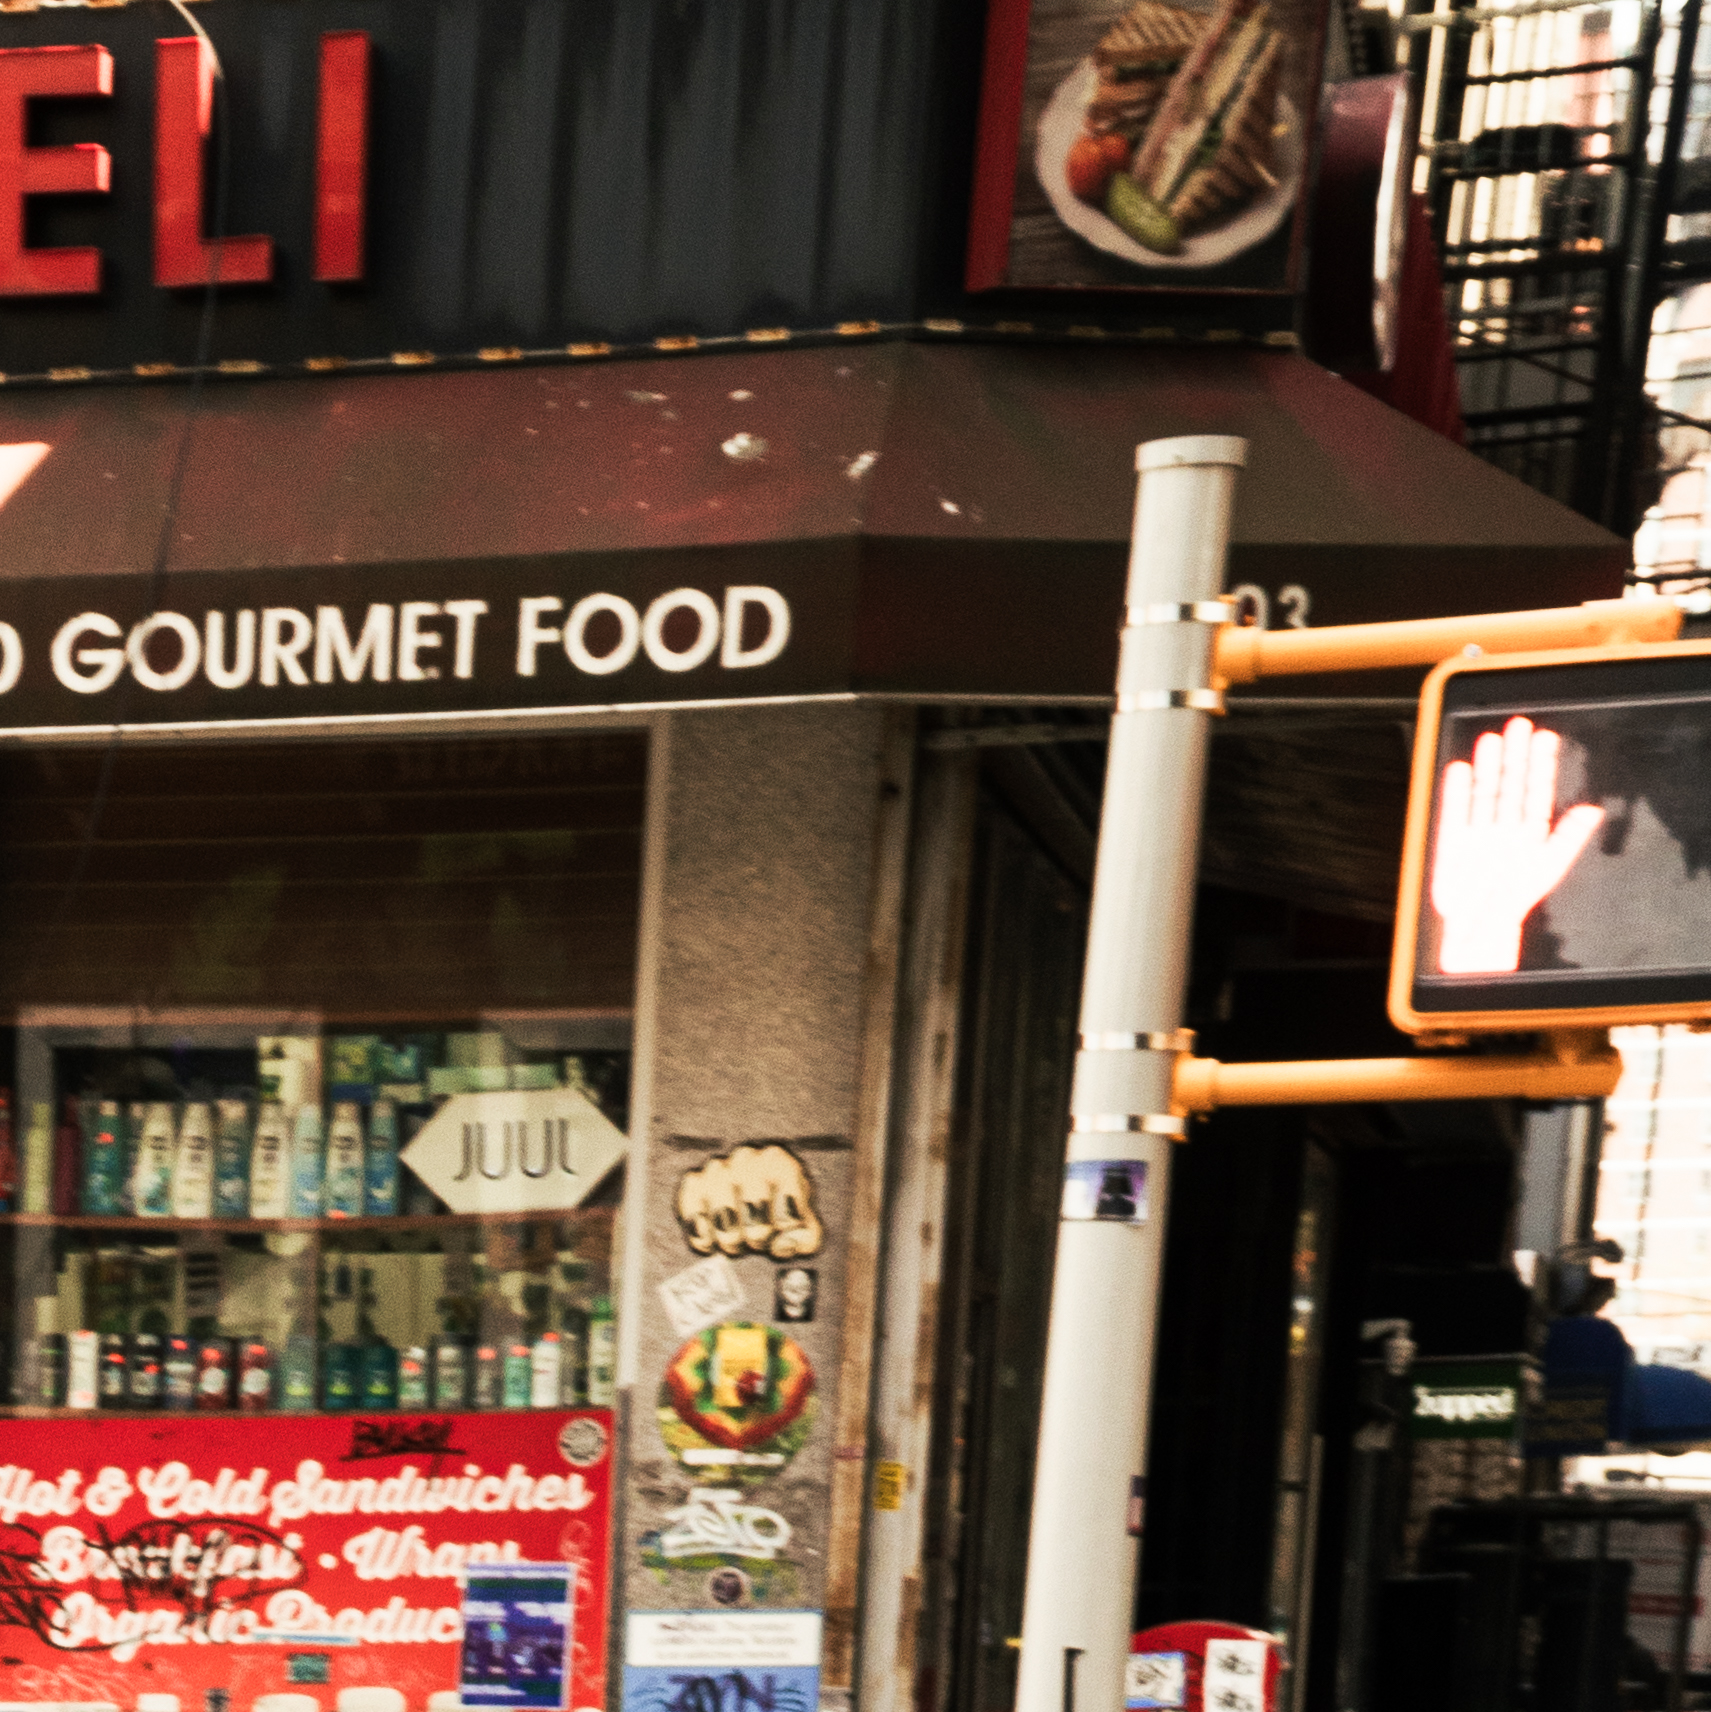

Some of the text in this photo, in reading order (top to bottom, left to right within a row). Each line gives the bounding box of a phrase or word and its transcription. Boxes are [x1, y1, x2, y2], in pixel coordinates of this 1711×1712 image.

[49, 600, 487, 694] GOURMET
[514, 584, 792, 678] FOOD
[452, 1117, 581, 1183] JUUL
[85, 1465, 134, 1517] &
[137, 1460, 270, 1518] Cold
[268, 1459, 596, 1528] Sandwiches
[49, 1589, 466, 1662] Organic Produc
